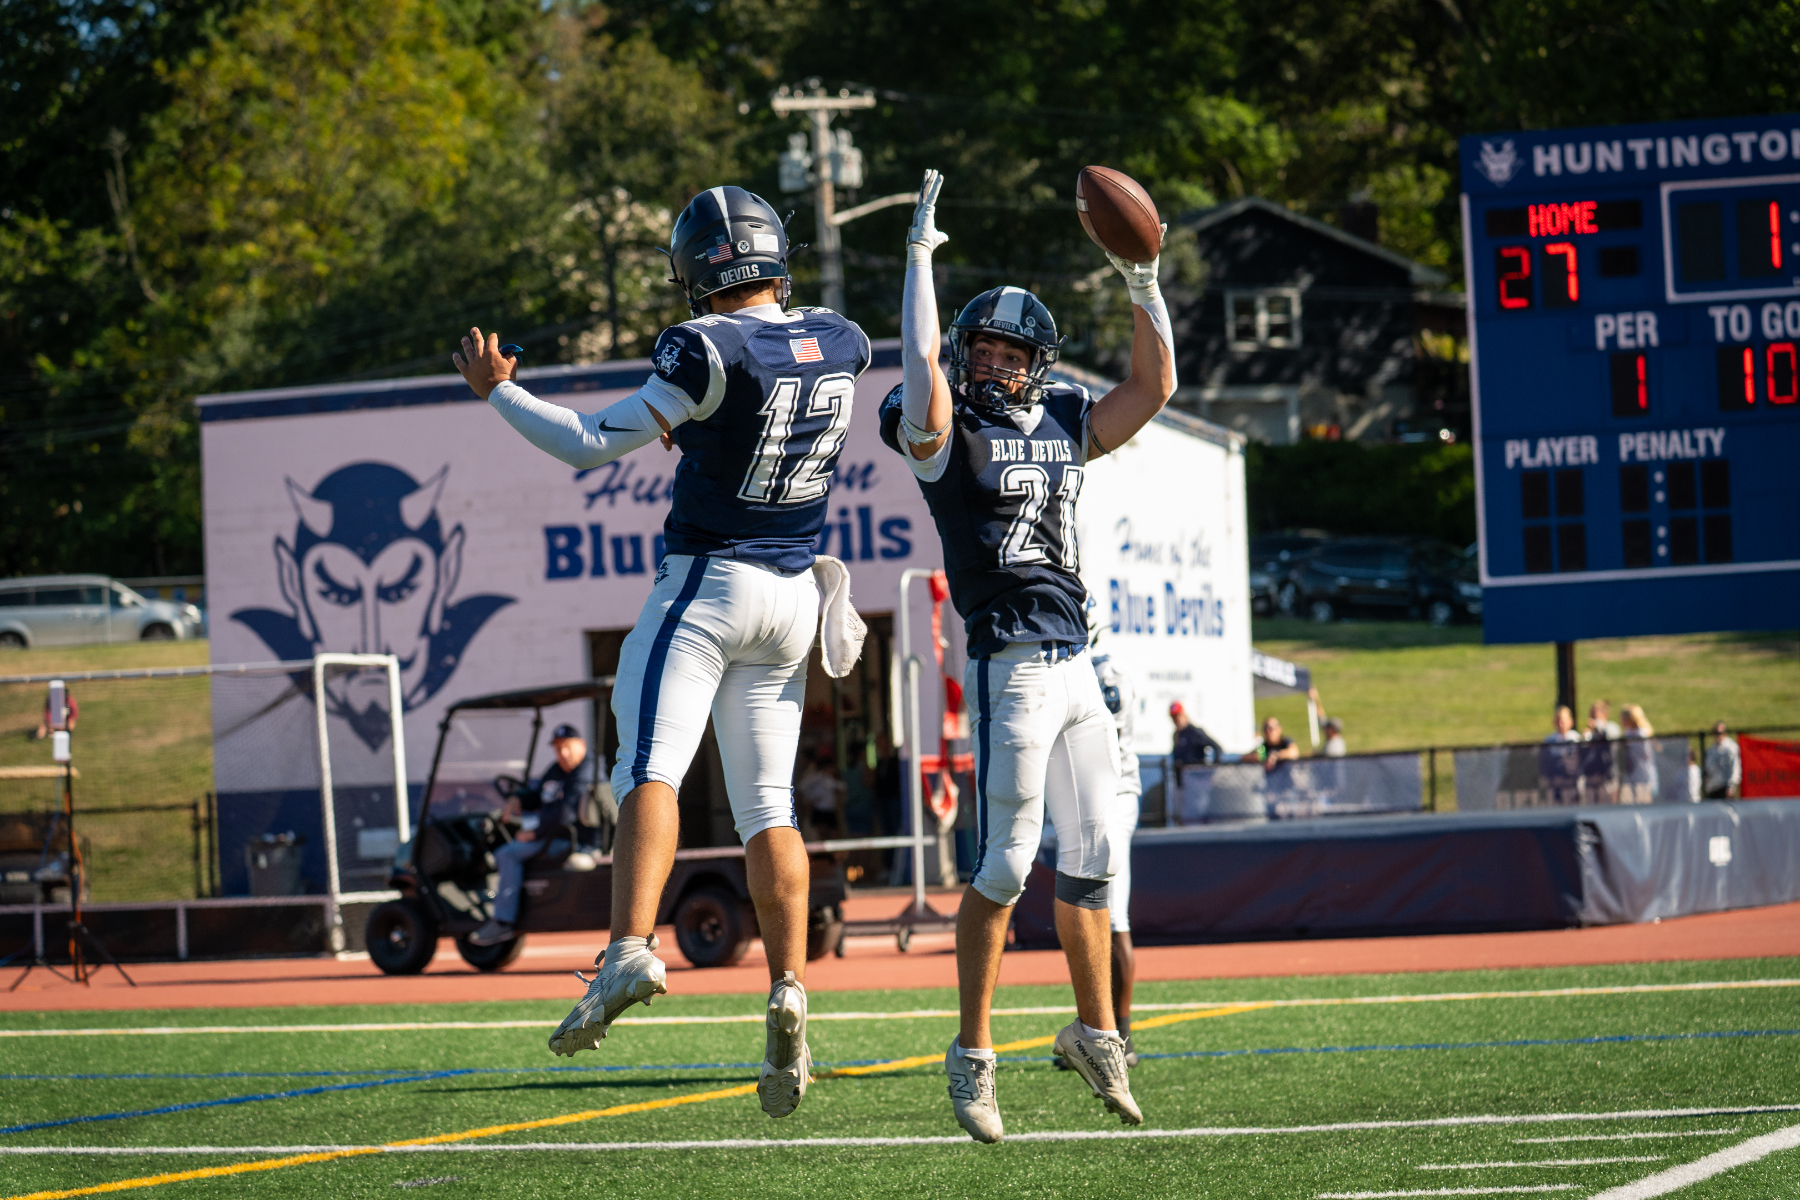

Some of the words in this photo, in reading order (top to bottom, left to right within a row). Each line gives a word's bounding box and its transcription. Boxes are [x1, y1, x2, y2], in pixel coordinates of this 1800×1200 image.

[1528, 201, 1598, 237] HOME
[720, 263, 760, 285] DEVILS
[1500, 243, 1579, 309] 27
[993, 320, 1016, 331] DEVILS
[1595, 311, 1658, 350] PER
[1708, 305, 1752, 342] TO
[1761, 301, 1800, 339] GO
[1635, 354, 1648, 409] 1
[1742, 342, 1798, 404] 10
[736, 372, 856, 503] 12
[990, 439, 1025, 462] BLUE
[1029, 439, 1073, 462] DEVILS
[1505, 434, 1599, 468] PLAYER
[1619, 427, 1725, 462] PENALTY
[998, 463, 1085, 573] 21
[1109, 579, 1155, 634] Blue
[1164, 581, 1224, 637] Devils
[1074, 1040, 1090, 1057] new
[1086, 1056, 1113, 1088] balance
